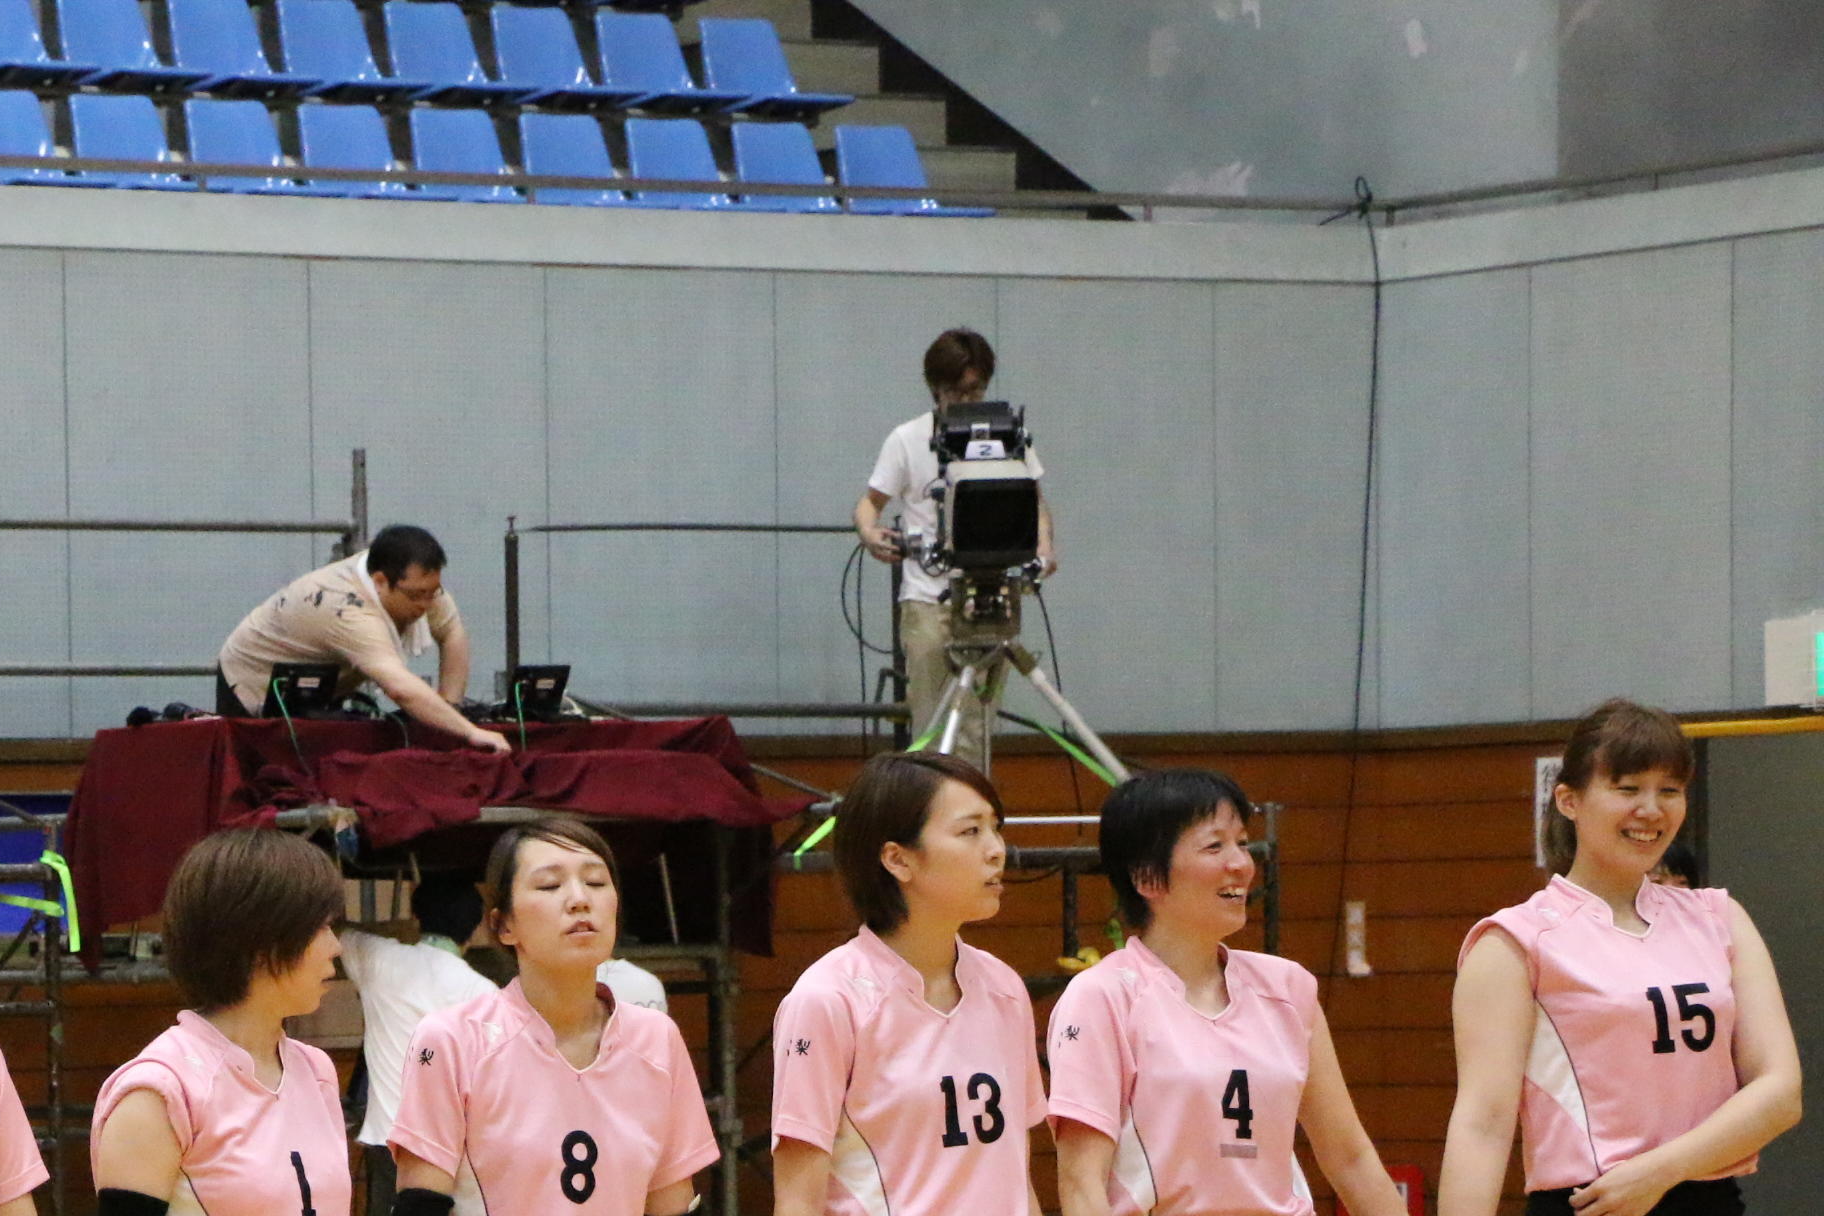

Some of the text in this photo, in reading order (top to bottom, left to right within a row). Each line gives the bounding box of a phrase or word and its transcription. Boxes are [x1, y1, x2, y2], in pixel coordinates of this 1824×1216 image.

[1644, 981, 1717, 1055] 15
[939, 1072, 1006, 1149] 13
[1221, 1068, 1254, 1140] 4
[560, 1130, 598, 1205] 8
